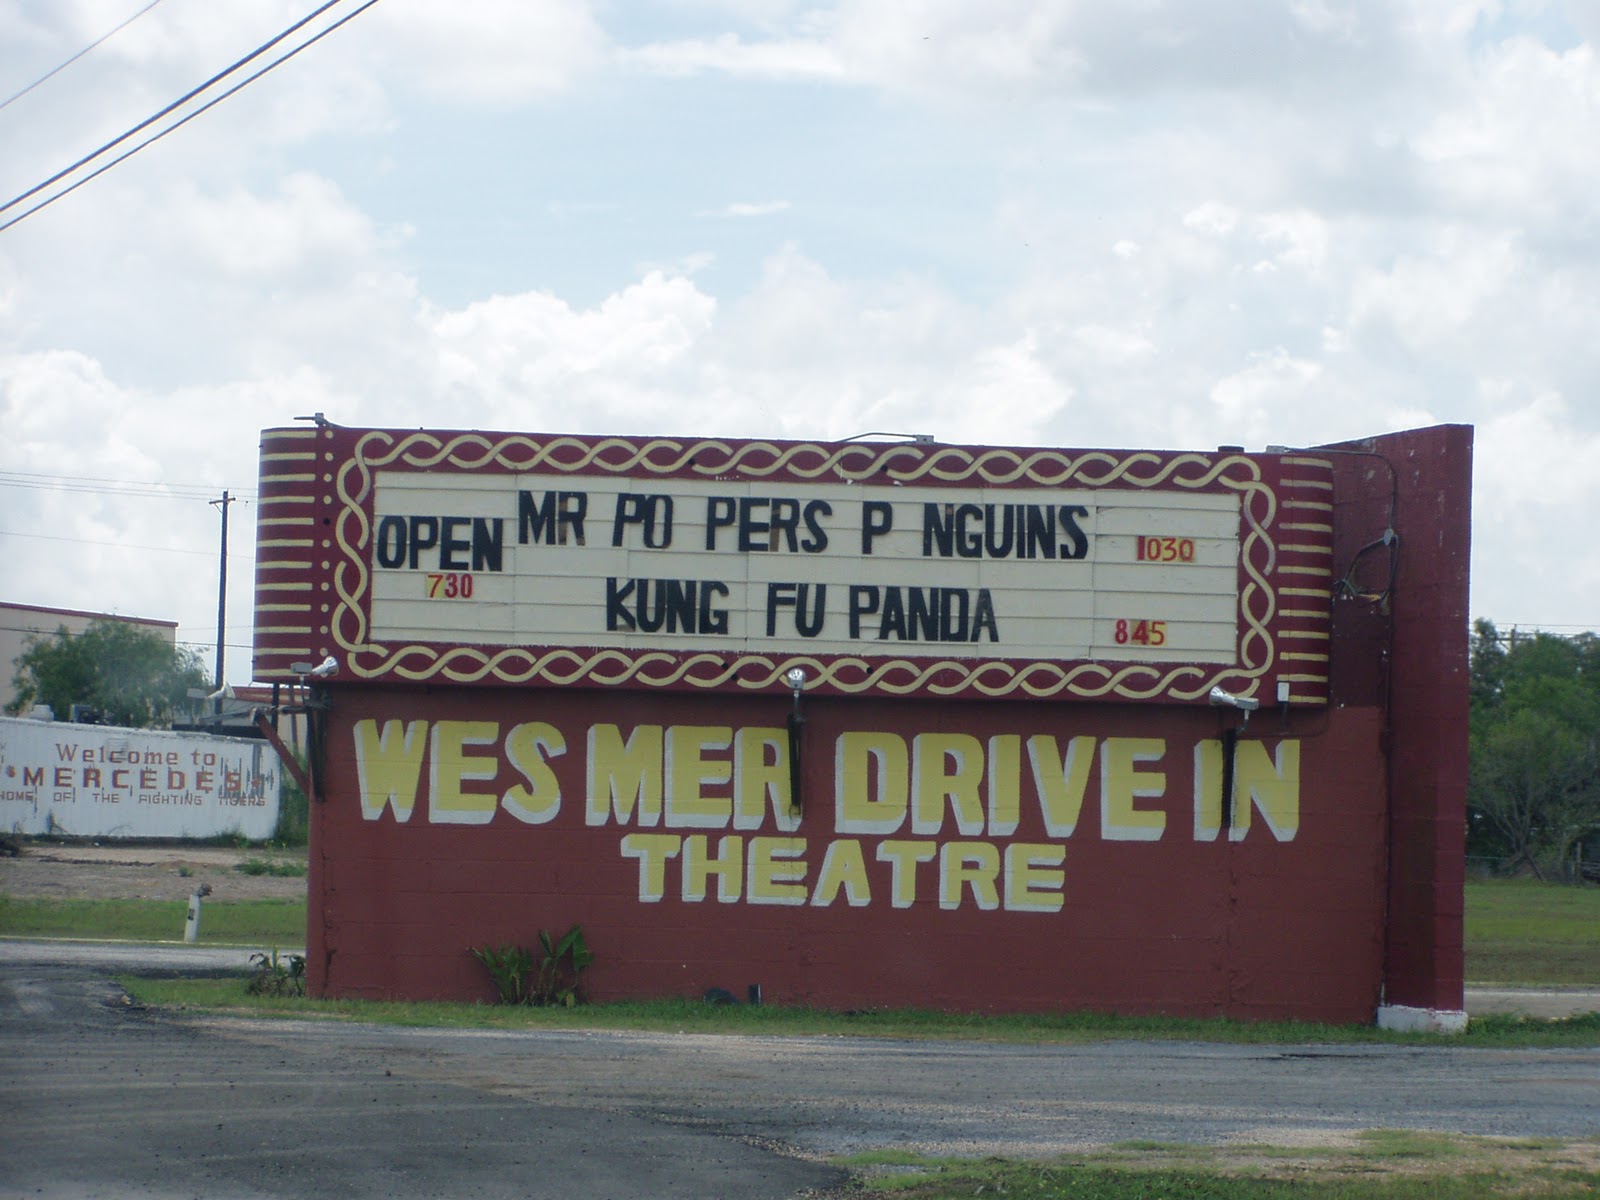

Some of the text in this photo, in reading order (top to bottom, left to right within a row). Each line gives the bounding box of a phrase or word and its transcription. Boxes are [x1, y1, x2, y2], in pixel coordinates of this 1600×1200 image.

[519, 490, 588, 547] MR
[612, 493, 674, 549] PO
[706, 496, 833, 554] PERS
[376, 515, 503, 572] OPEN
[1136, 535, 1195, 562] 1030
[427, 573, 474, 599] 730
[606, 577, 999, 643] KUNG FU PANDA
[1114, 619, 1166, 646] 845
[55, 743, 217, 767] Welcome to
[23, 765, 243, 792] MERCEDES
[353, 719, 1300, 842] WES MER DRIVE IN
[53, 792, 73, 803] OF
[92, 793, 120, 805] THE
[138, 794, 203, 807] FIGHTING
[620, 833, 1066, 912] THEATRE
